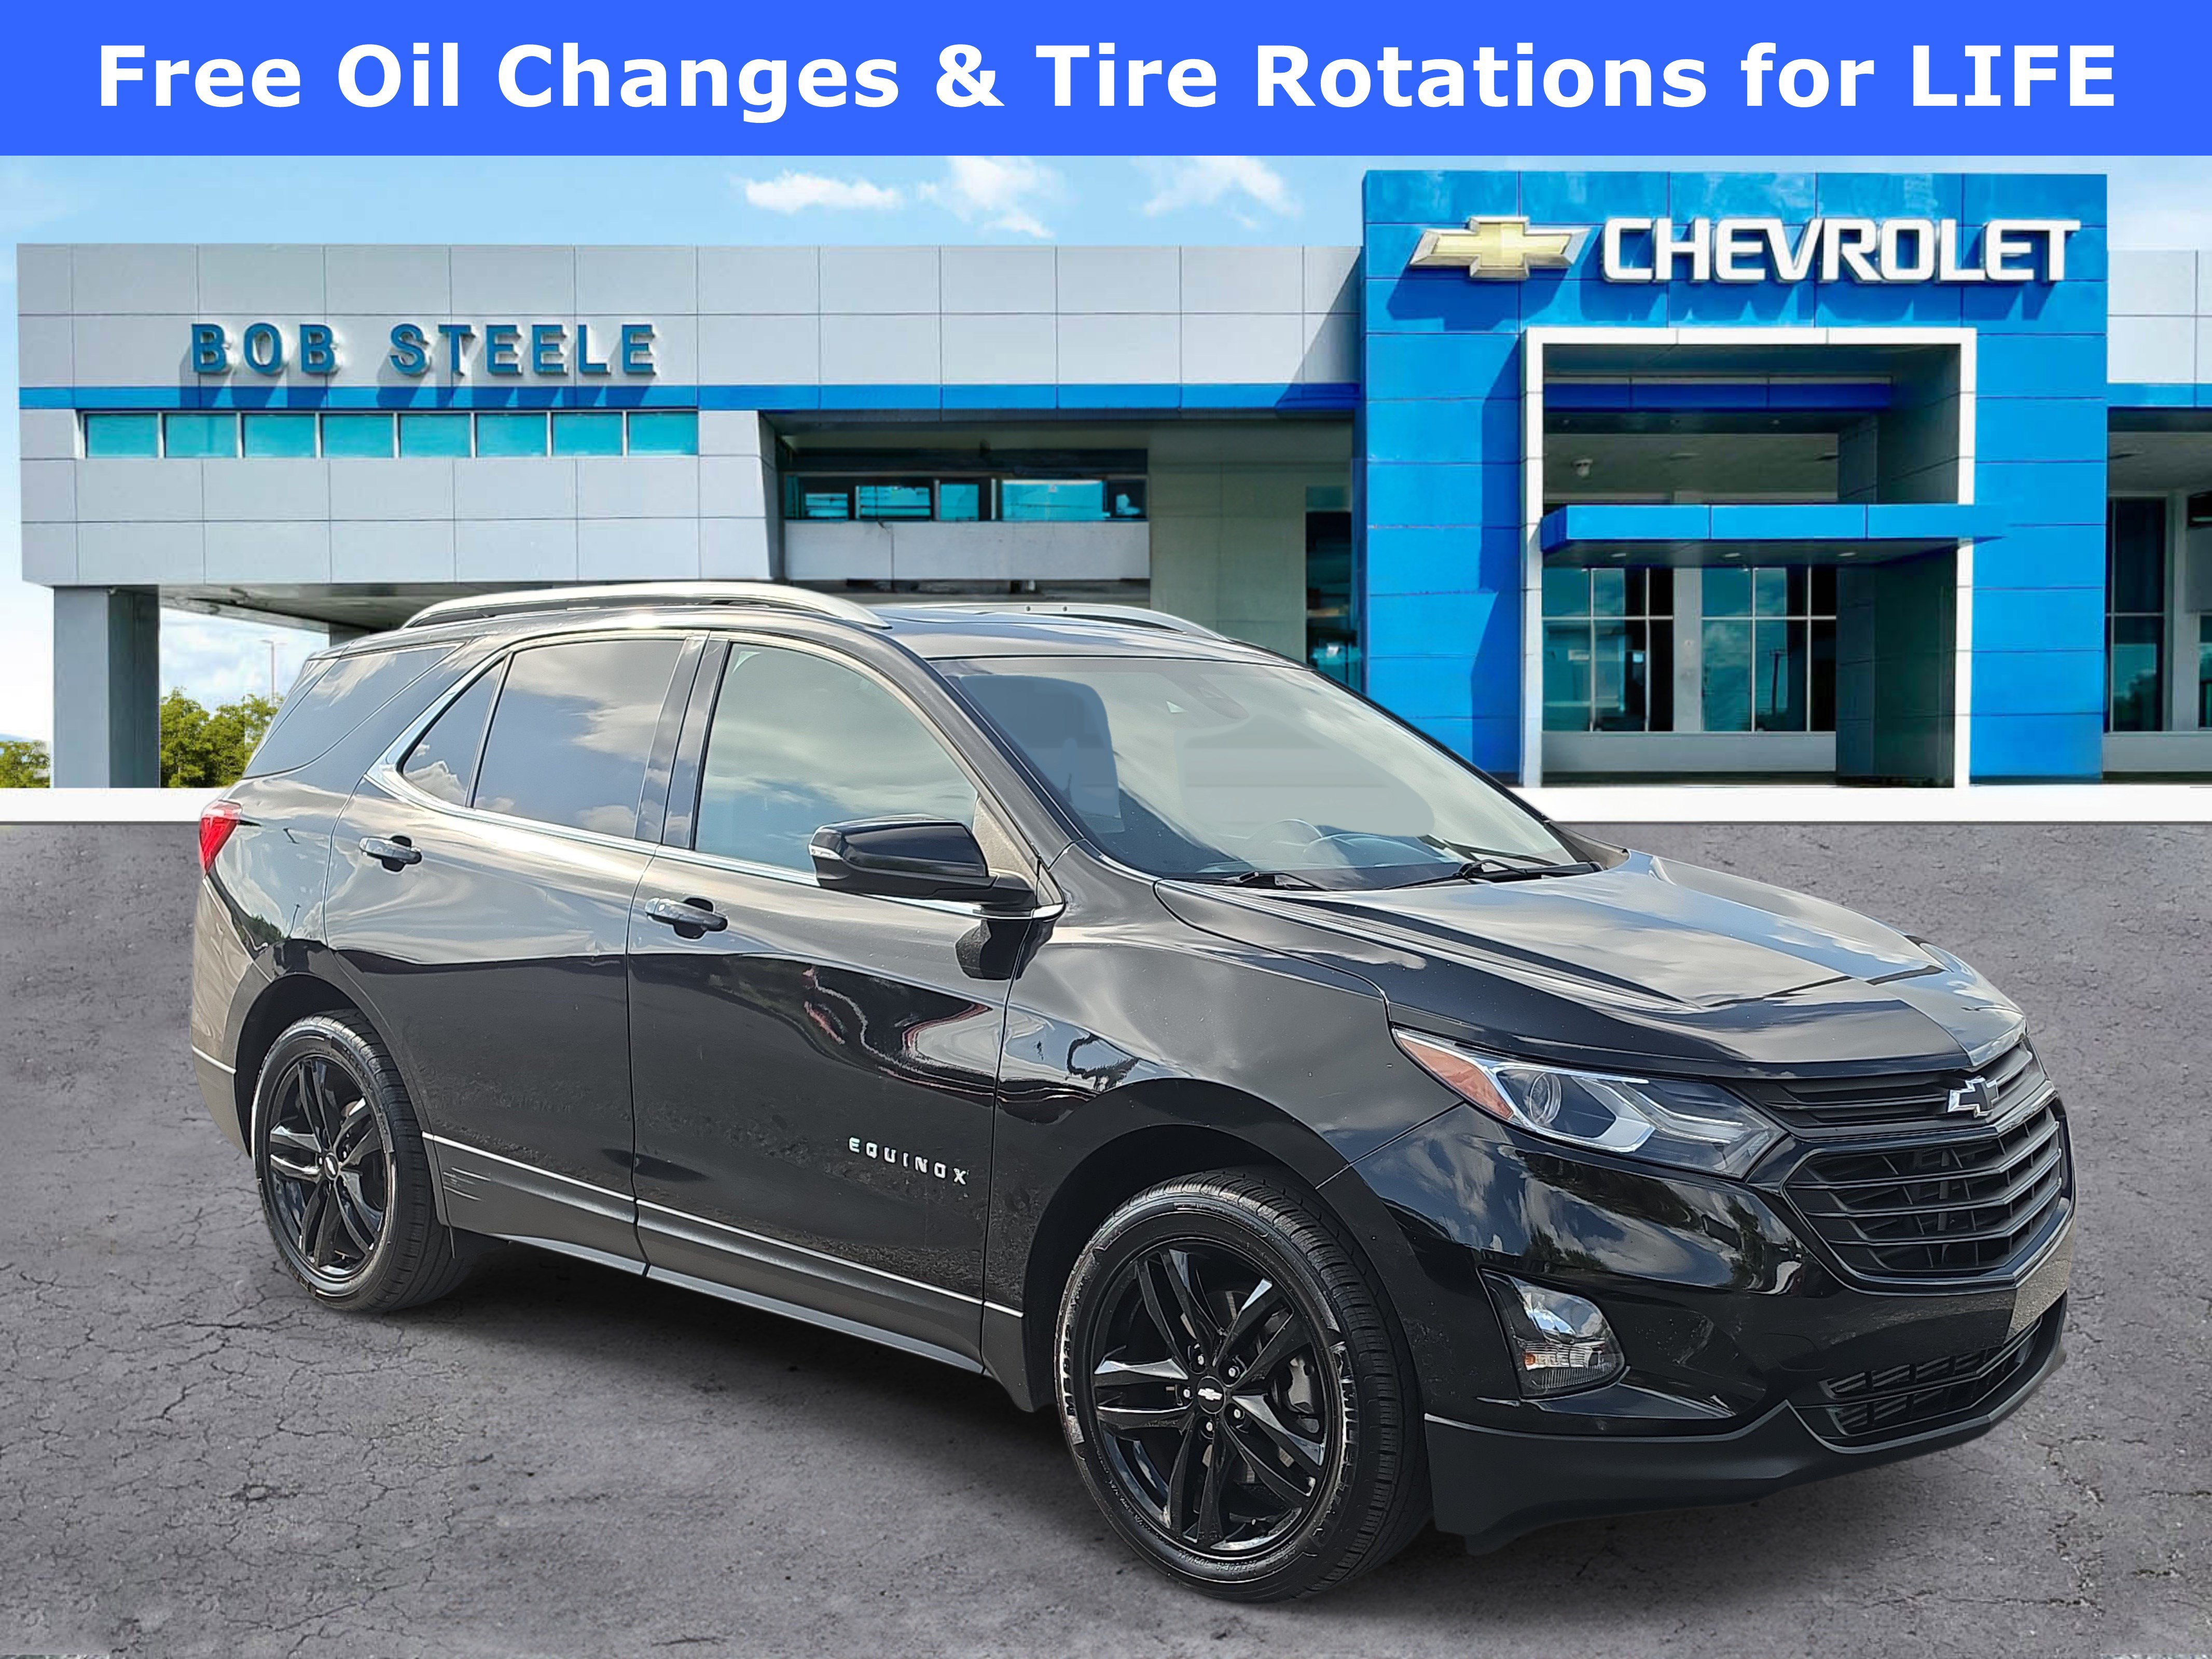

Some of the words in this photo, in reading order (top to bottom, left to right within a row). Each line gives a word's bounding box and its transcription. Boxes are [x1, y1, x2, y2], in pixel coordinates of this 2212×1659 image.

[1603, 218, 2081, 283] CHEVROLET
[191, 323, 337, 376] BOB
[390, 323, 655, 376] STEELE
[849, 1137, 966, 1185] EQUINOX
